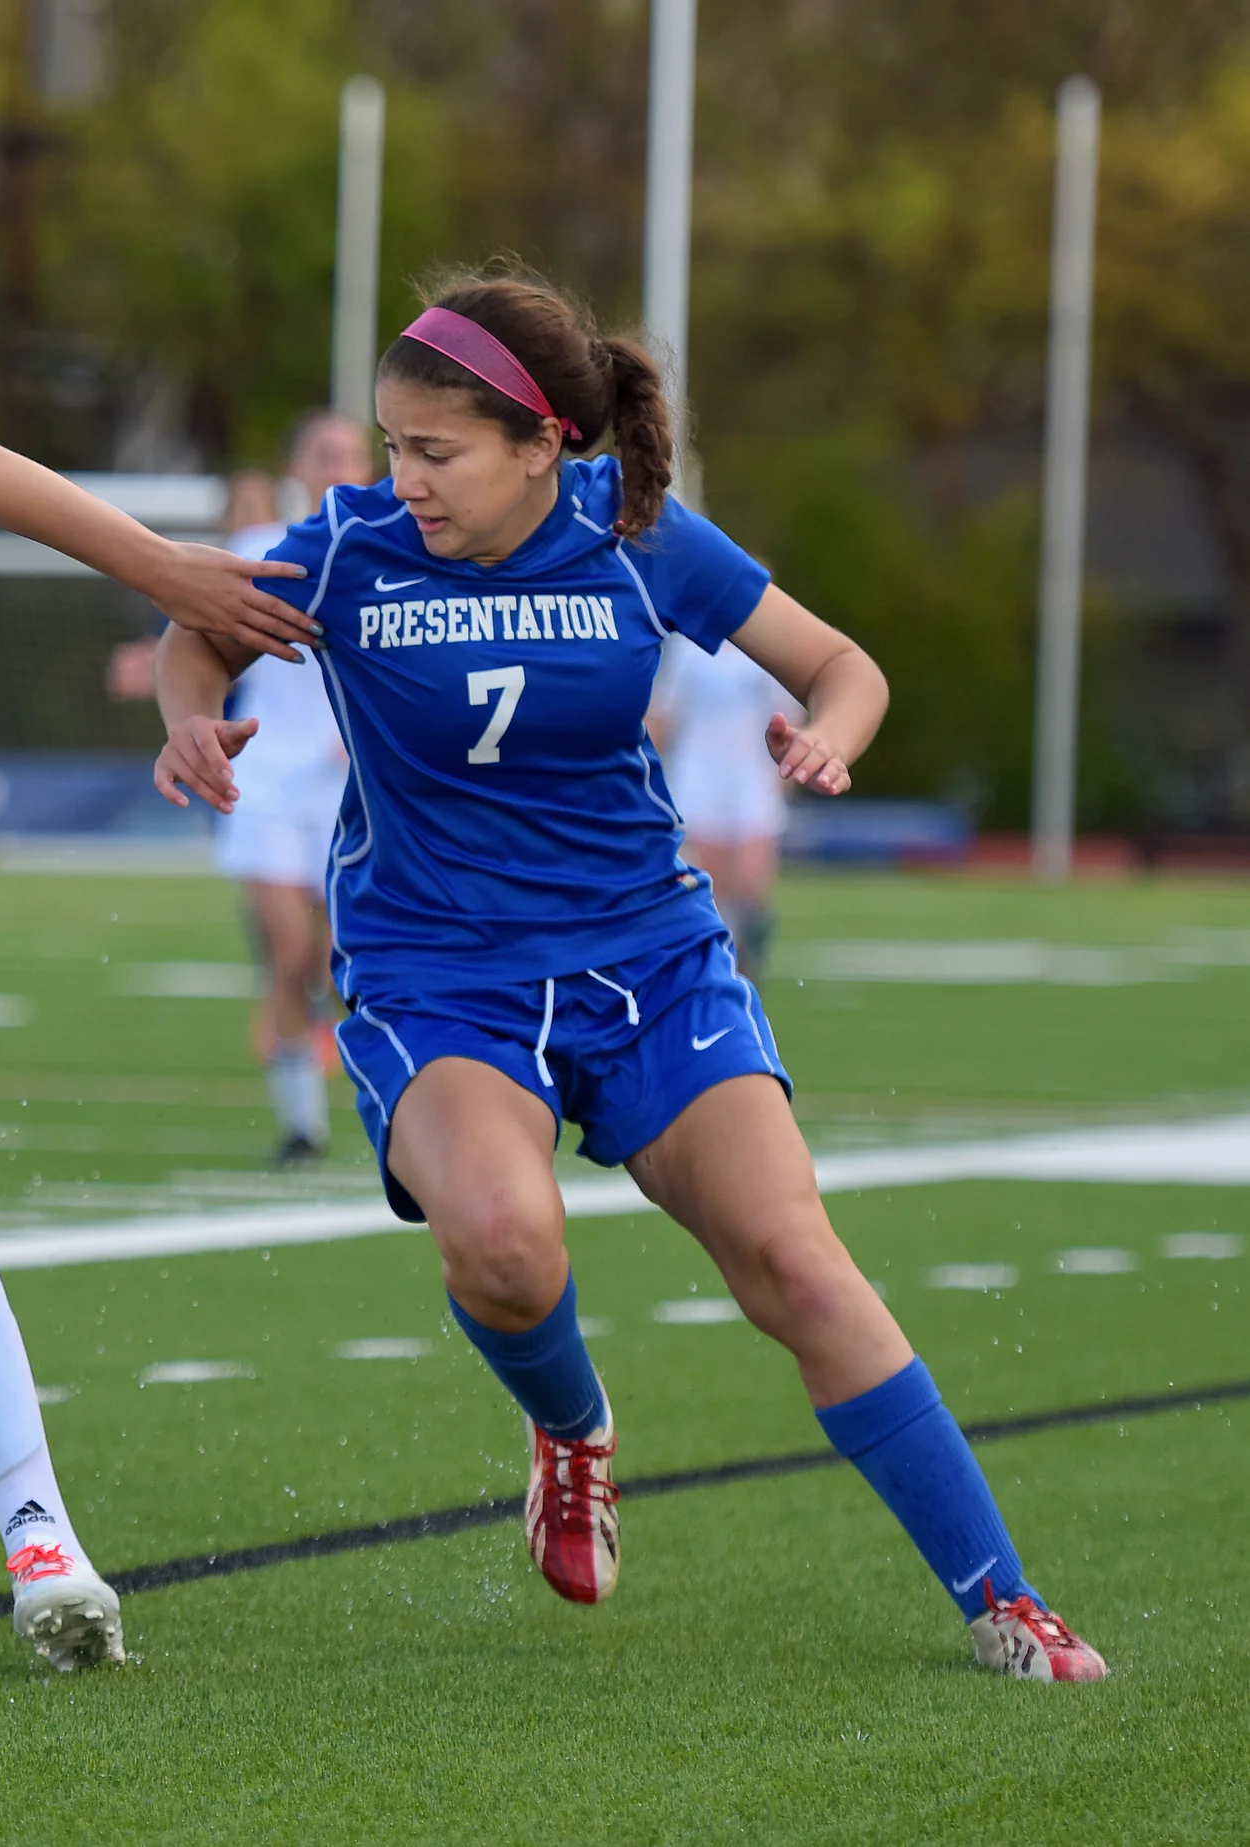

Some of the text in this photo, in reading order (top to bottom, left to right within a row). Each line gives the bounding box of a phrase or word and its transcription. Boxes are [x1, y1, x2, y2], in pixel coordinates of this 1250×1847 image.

[359, 595, 620, 649] PRESENTATION
[466, 665, 526, 765] 7
[5, 1512, 56, 1536] adidas
